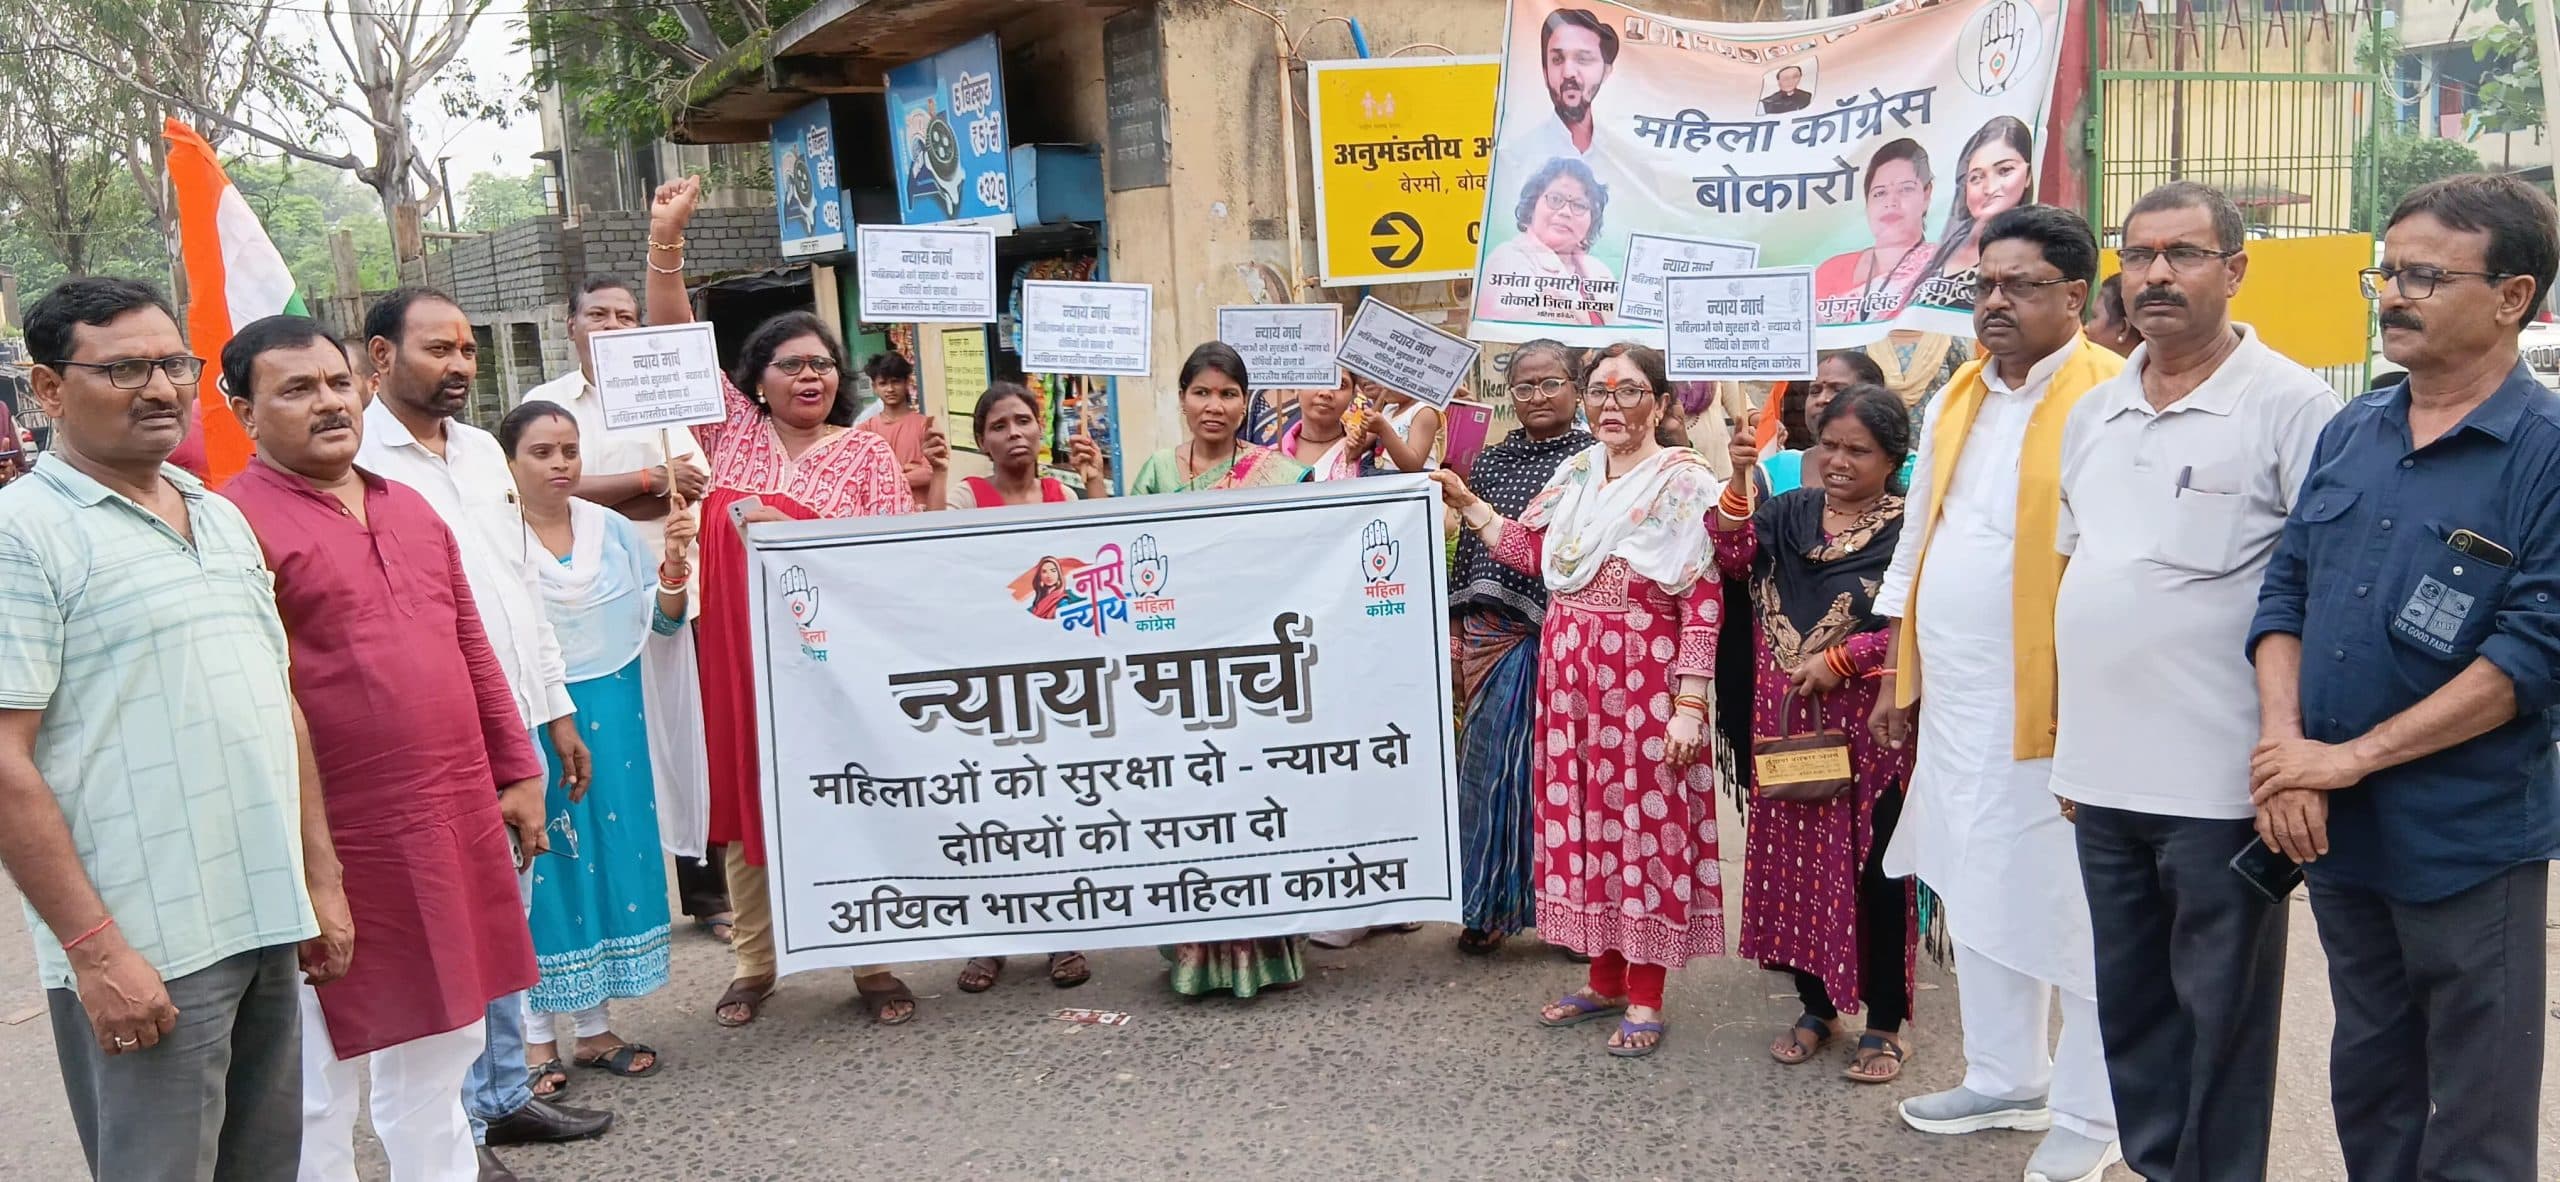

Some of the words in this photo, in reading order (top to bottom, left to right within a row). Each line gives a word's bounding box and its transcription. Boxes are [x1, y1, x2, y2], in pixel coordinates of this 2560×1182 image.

[1633, 108, 1780, 153] महिला
[1334, 134, 1463, 171] अनुमंडलीय
[1692, 155, 1860, 213] बोकारो
[1662, 258, 1690, 273] न्याय
[1488, 271, 1530, 288] अजंता
[1534, 274, 1579, 292] कुमारी
[1584, 279, 1619, 295] साम
[1500, 292, 1540, 307] बोकारो
[1543, 294, 1572, 310] जिला
[1576, 300, 1614, 312] अध्यक्ष
[1707, 299, 1737, 316] न्याय
[1740, 295, 1764, 316] मार्च
[1818, 295, 1861, 317] गुंजन
[1866, 292, 1900, 312] सिंह
[1255, 326, 1280, 339] न्याय
[1676, 356, 1705, 369] अखिल
[1707, 356, 1739, 369] भारतीय
[1740, 356, 1769, 370] महिला
[1073, 543, 1127, 612] नारी
[1364, 580, 1405, 598] महिला
[1060, 594, 1131, 634] न्याय
[1134, 595, 1175, 613] महिला
[1366, 600, 1405, 617] कांग्रेस
[1135, 615, 1176, 632] कांग्रेस
[2407, 626, 2430, 643] GOOD
[888, 656, 1116, 740] न्याय
[1126, 612, 1314, 725] मार्च
[809, 759, 982, 808] महिलाओं
[991, 753, 1048, 799] को
[1056, 755, 1175, 807] सुरक्षा
[1184, 739, 1227, 787] दो
[1262, 739, 1360, 775] न्याय
[1369, 722, 1411, 768] दो
[938, 814, 1066, 867] दोषियों
[1075, 808, 1131, 854] को
[1141, 812, 1237, 849] सजा
[1246, 796, 1288, 842] दो
[828, 884, 970, 934] अखिल
[981, 876, 1134, 924] भारतीय
[1144, 867, 1272, 913] महिला
[1281, 852, 1408, 901] कांग्रेस
